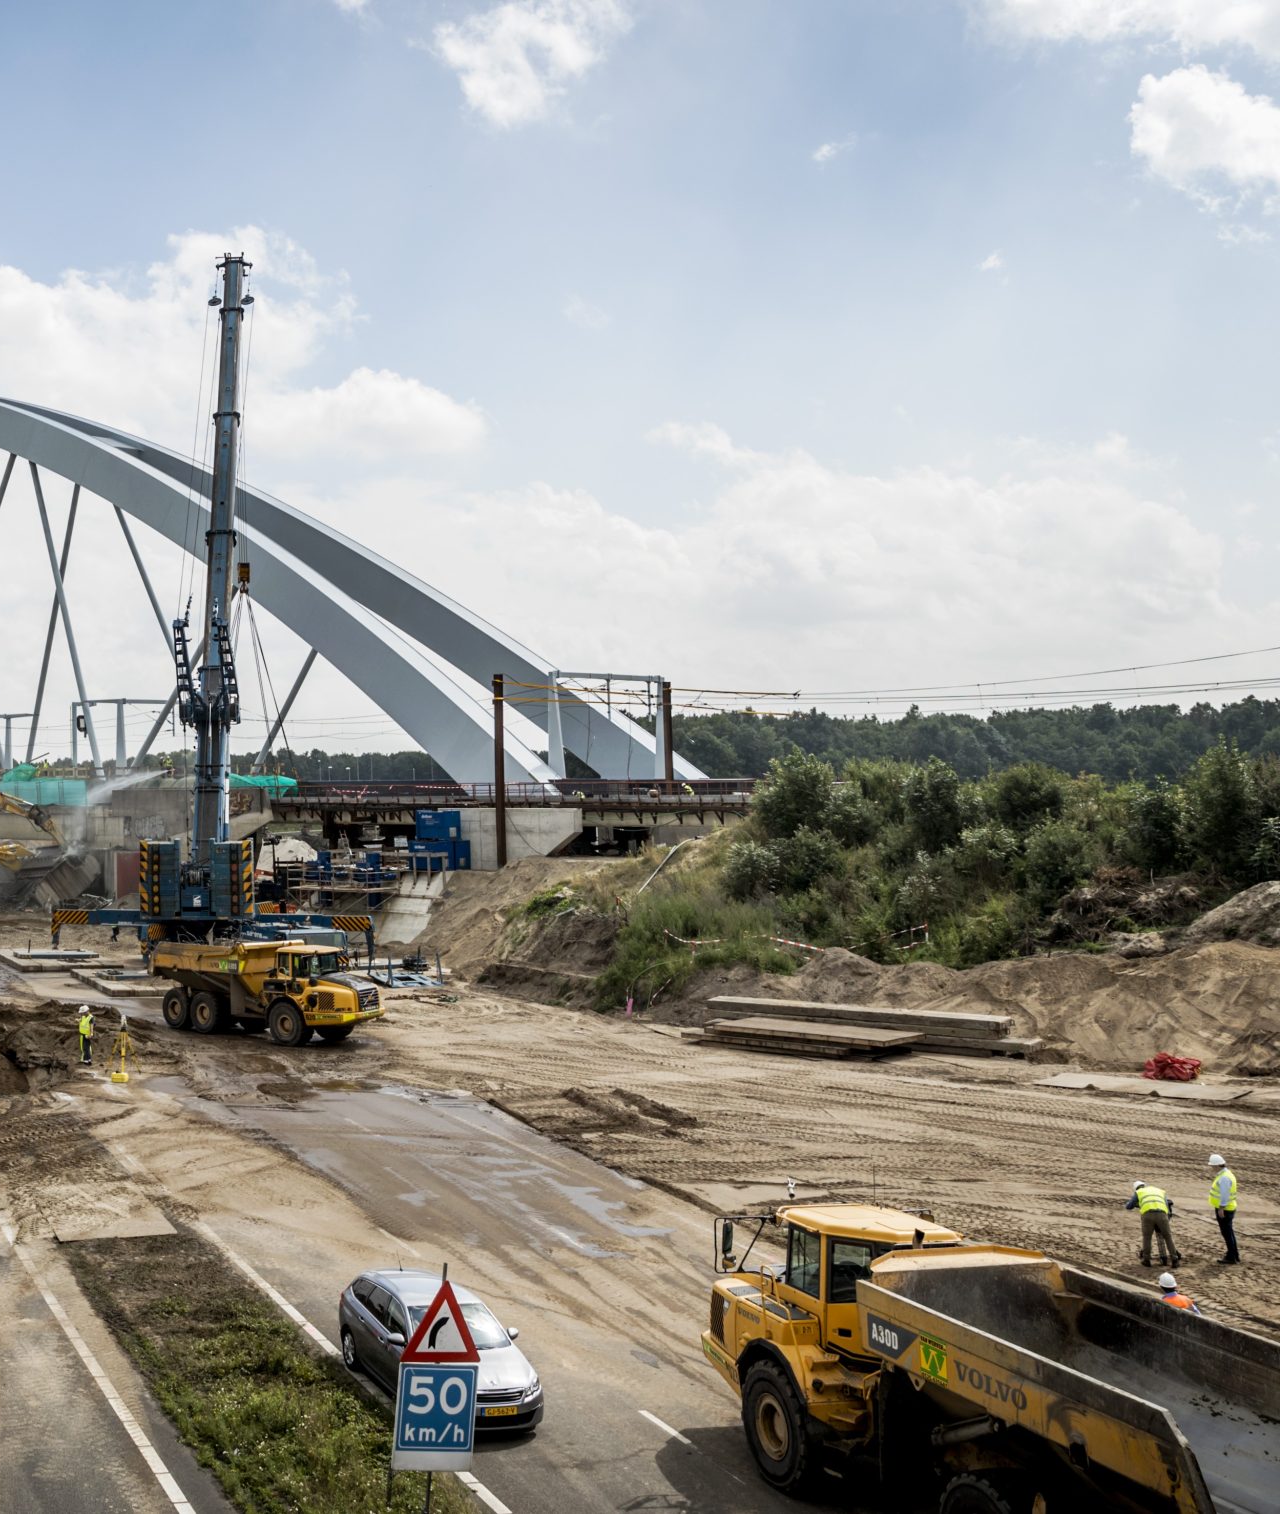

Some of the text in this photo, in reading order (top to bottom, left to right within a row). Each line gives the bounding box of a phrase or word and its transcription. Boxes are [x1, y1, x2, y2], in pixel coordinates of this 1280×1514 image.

[871, 1322, 899, 1351] A30D
[407, 1375, 468, 1415] 50
[952, 1359, 1028, 1411] VOLVO
[404, 1422, 465, 1443] km/h
